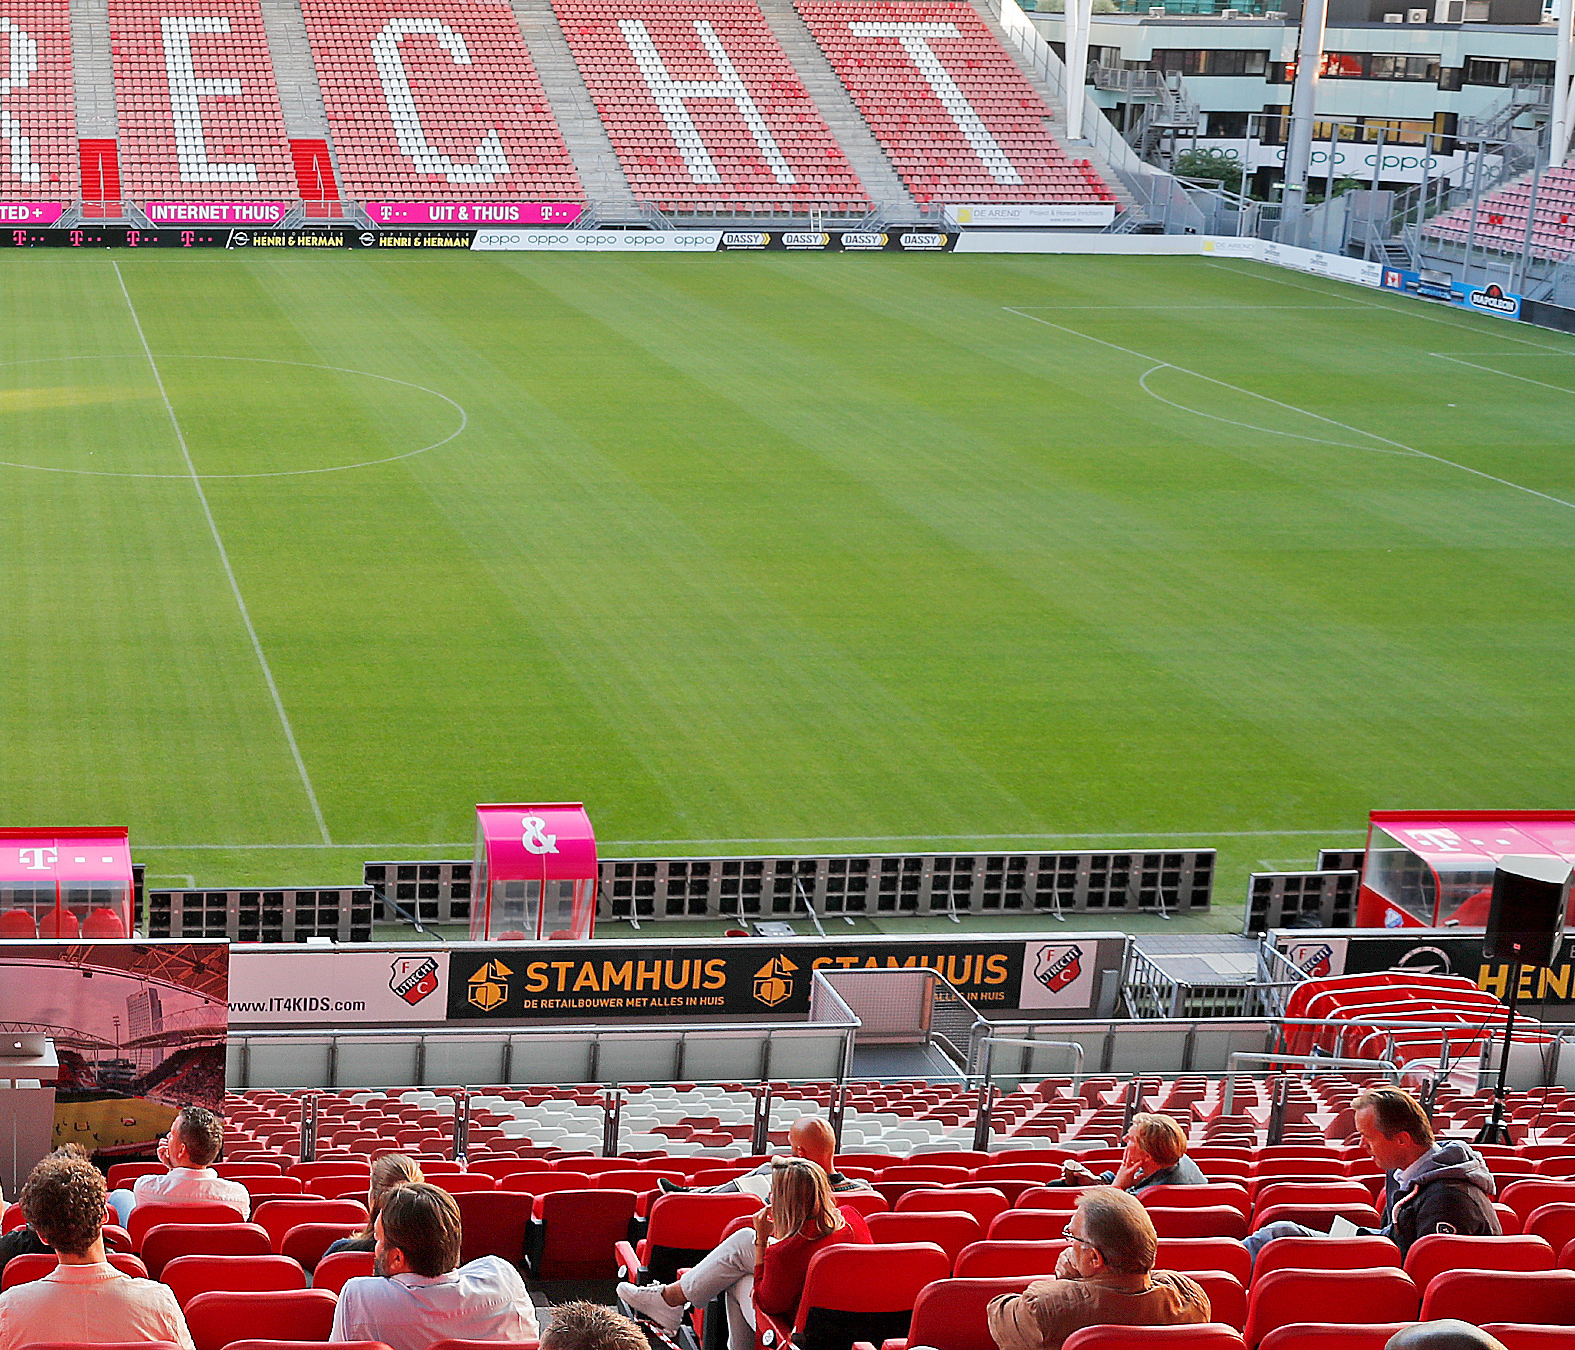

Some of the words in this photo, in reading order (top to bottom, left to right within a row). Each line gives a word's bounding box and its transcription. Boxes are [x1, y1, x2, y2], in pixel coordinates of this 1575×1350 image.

[1365, 154, 1437, 171] oppo
[32, 209, 43, 218] +
[152, 206, 229, 219] INTERNET
[234, 206, 280, 219] THUIS
[429, 207, 455, 220] UIT
[459, 207, 470, 220] &
[474, 207, 519, 220] THUIS
[253, 236, 285, 246] HENRI
[288, 236, 295, 246] &
[298, 236, 343, 246] HERMAN
[379, 237, 411, 247] HENRI
[414, 237, 421, 247] &
[424, 237, 469, 247] HERMAN
[479, 235, 520, 244] oppo
[528, 235, 569, 244] oppo
[576, 235, 617, 244] oppo
[625, 235, 665, 244] oppo
[674, 236, 715, 245] oppo
[727, 235, 760, 243] DASSY
[786, 235, 819, 243] DASSY
[845, 235, 878, 243] DASSY
[904, 235, 937, 243] DASSY
[1473, 294, 1515, 311] NAPOLEON
[521, 816, 560, 854] &
[1047, 950, 1055, 960] F
[1299, 949, 1307, 960] F
[401, 962, 409, 973] F
[1039, 949, 1079, 984] UTRECHT
[395, 960, 435, 996] UTRECHT
[525, 959, 726, 992] STAMHUIS
[1059, 970, 1070, 982] C
[417, 982, 428, 994] C
[967, 992, 978, 1000] IN
[980, 992, 1005, 1000] HUIS
[228, 997, 366, 1012] www.IT4KIDS.com
[524, 1000, 537, 1008] DE
[541, 999, 623, 1008] RETAILBOUWER
[626, 998, 647, 1007] MET
[651, 997, 683, 1006] ALLES
[686, 997, 696, 1005] IN
[700, 996, 724, 1005] HUIS
